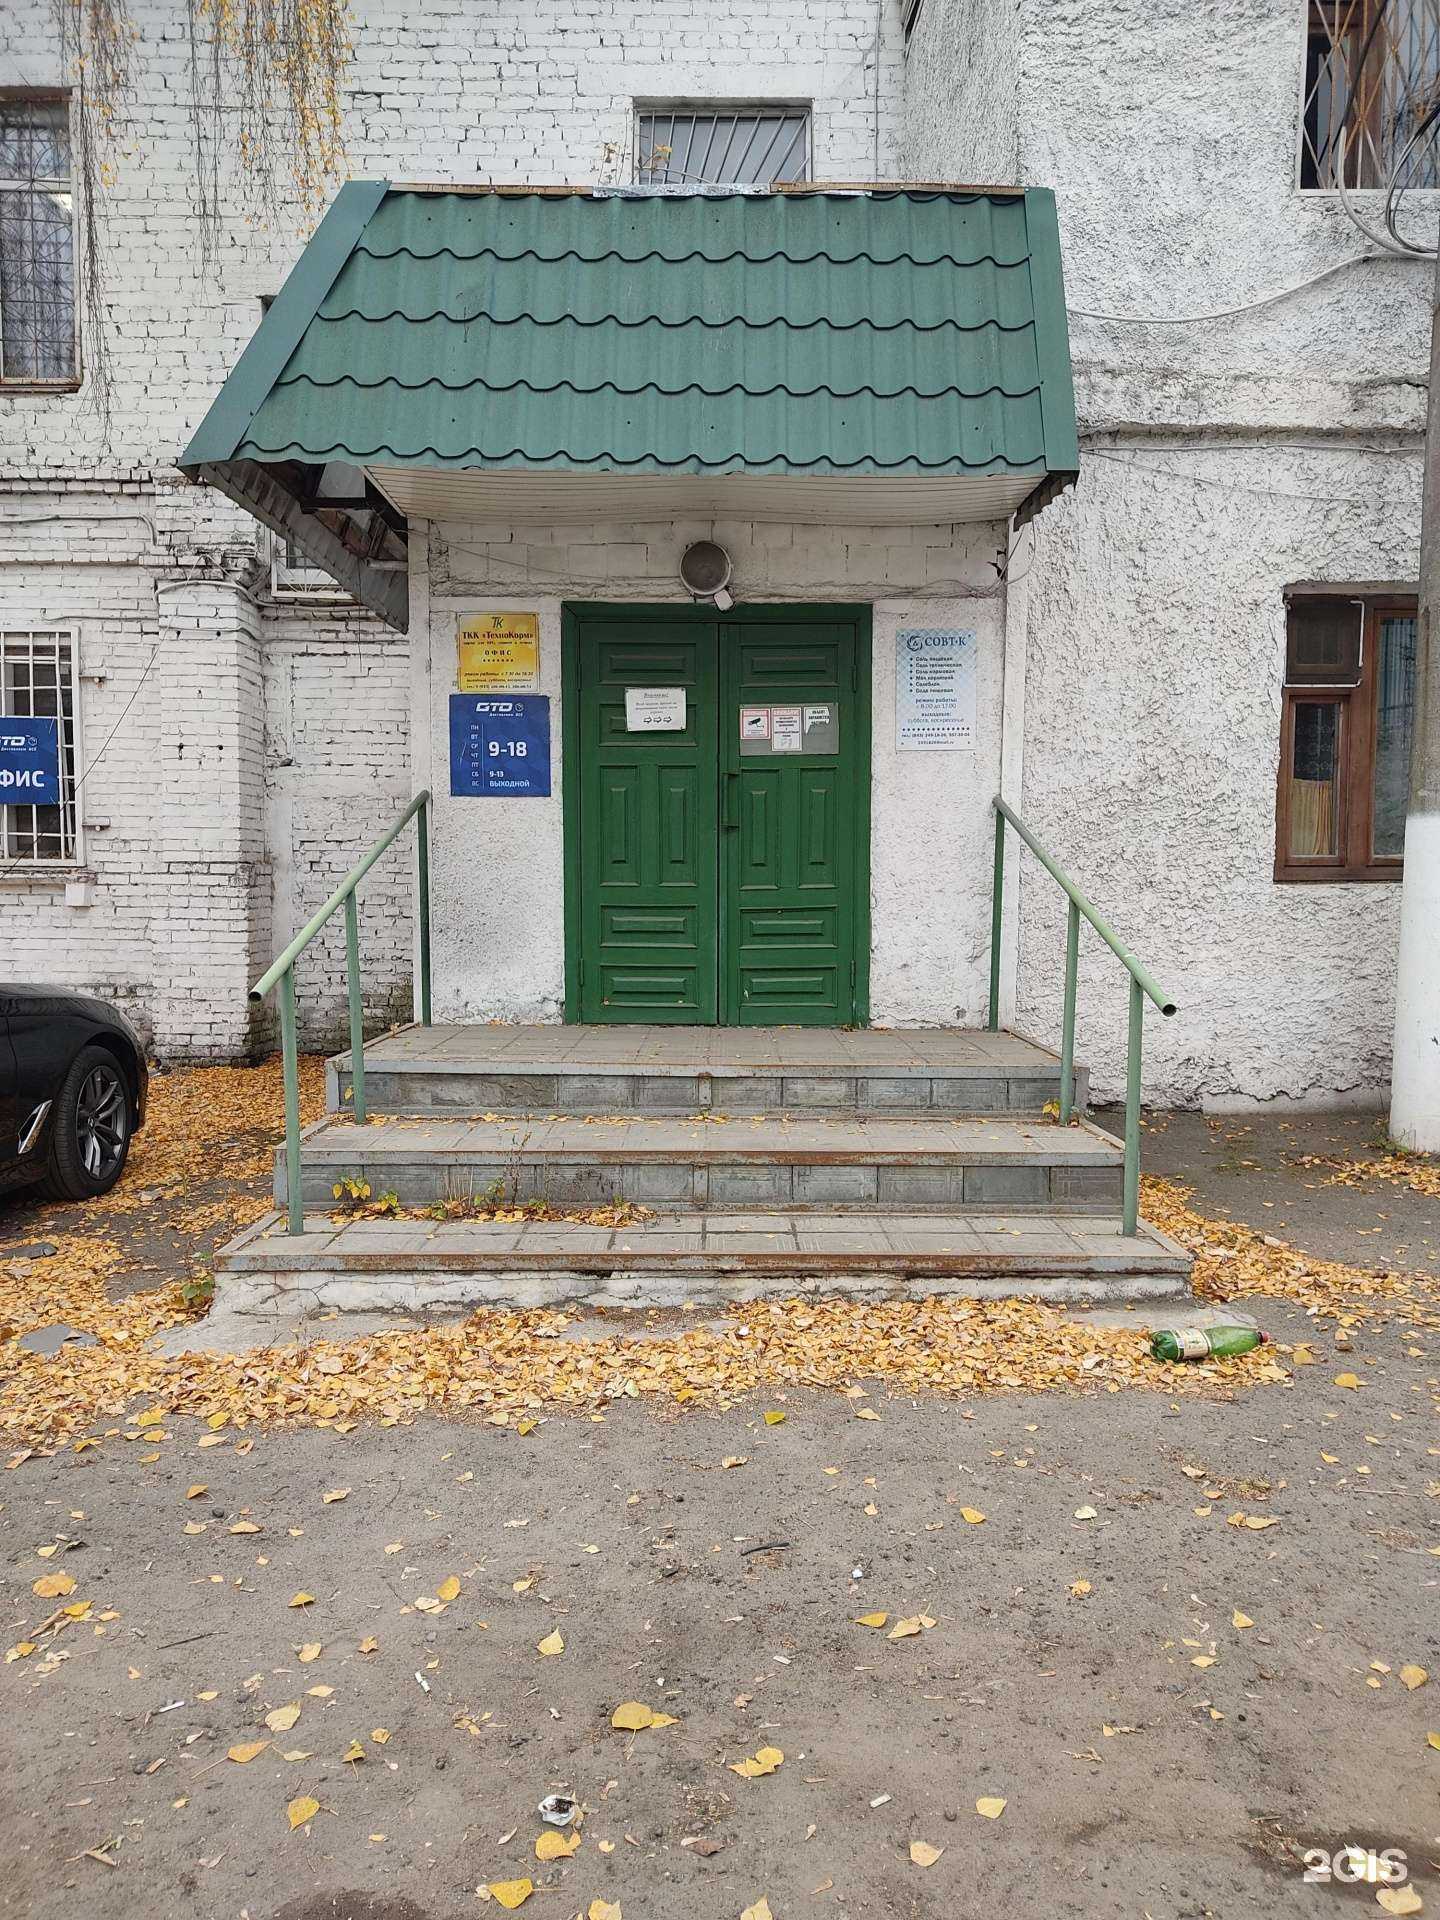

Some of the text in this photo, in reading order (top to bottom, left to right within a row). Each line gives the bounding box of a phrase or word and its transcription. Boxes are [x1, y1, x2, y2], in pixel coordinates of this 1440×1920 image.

[462, 631, 534, 641] ТКК «ТехноКорм»
[488, 741, 528, 757] 9-18
[489, 779, 530, 788] ВЫХОДНОЙ
